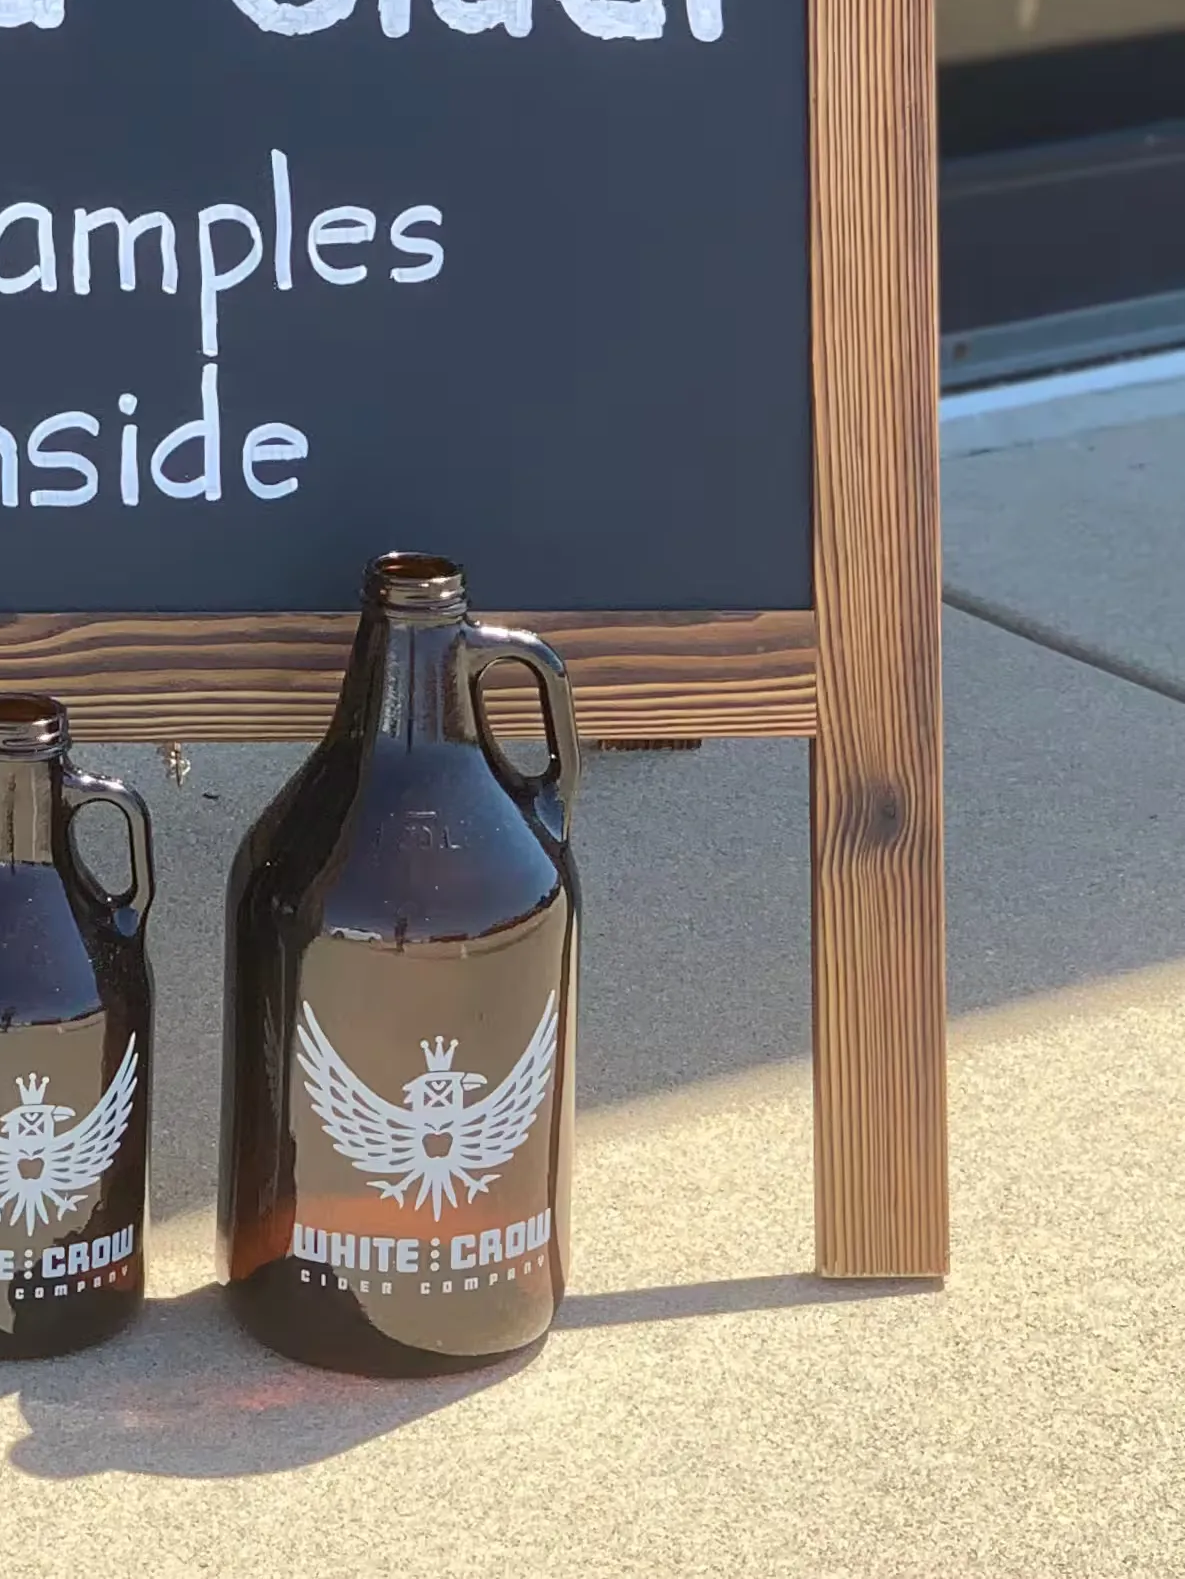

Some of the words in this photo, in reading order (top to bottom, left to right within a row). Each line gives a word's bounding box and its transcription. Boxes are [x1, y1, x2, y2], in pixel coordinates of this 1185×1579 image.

[41, 1223, 135, 1280] CROW
[293, 1222, 419, 1273] WHITE
[450, 1207, 552, 1271] CROW
[14, 1265, 130, 1300] COMPANY
[300, 1269, 393, 1295] CIDER
[419, 1254, 546, 1295] COMPANY
